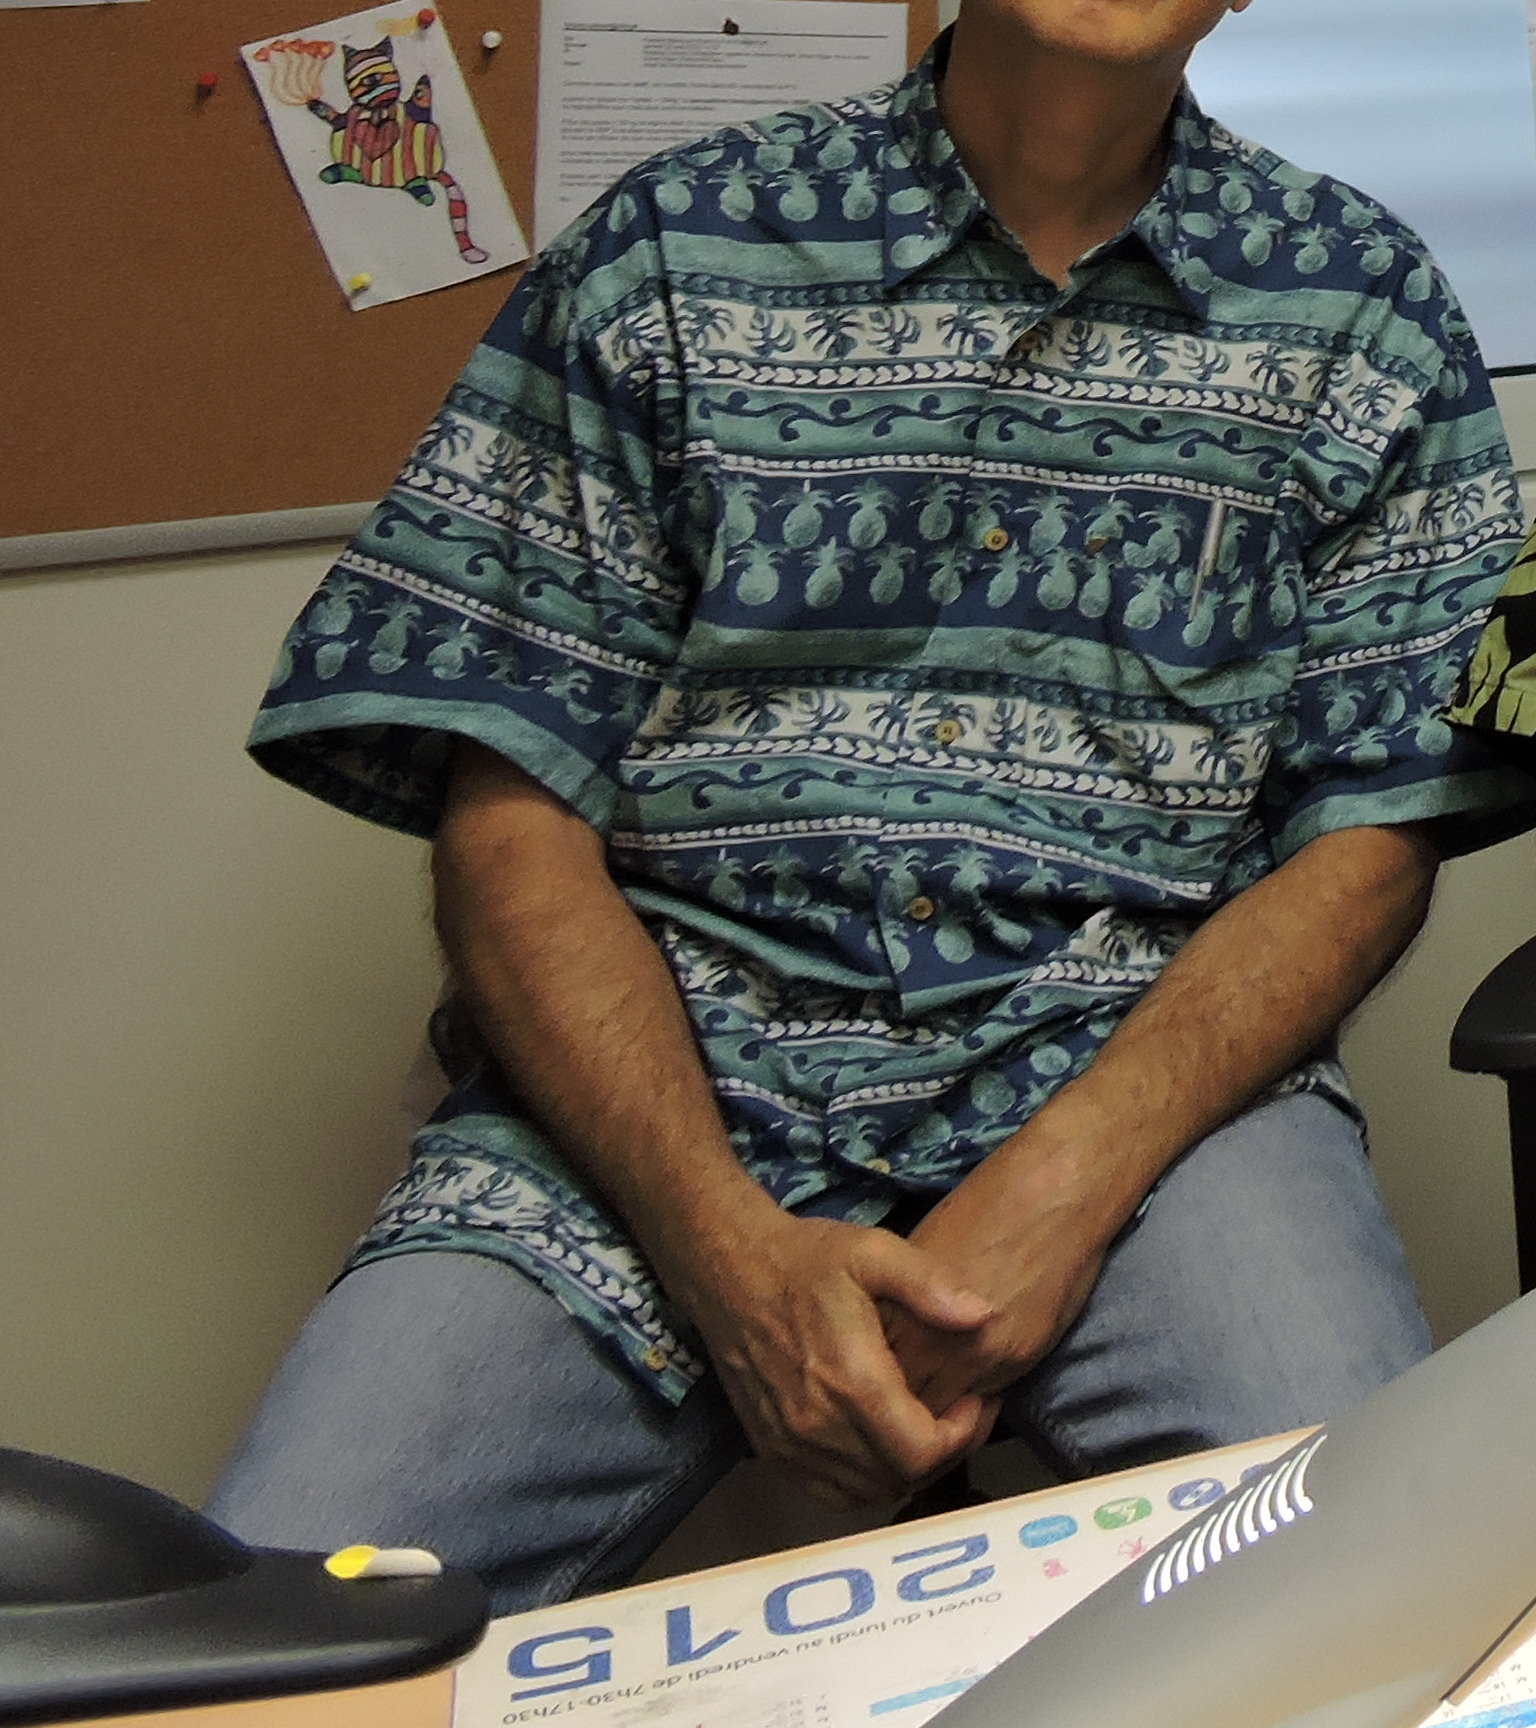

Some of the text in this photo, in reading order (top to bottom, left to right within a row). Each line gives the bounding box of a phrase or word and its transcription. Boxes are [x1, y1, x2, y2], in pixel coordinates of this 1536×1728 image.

[501, 1591, 1003, 1726] Ouvert du lundi au vendredi de 7h30-17h30
[506, 1533, 997, 1703] 2015
